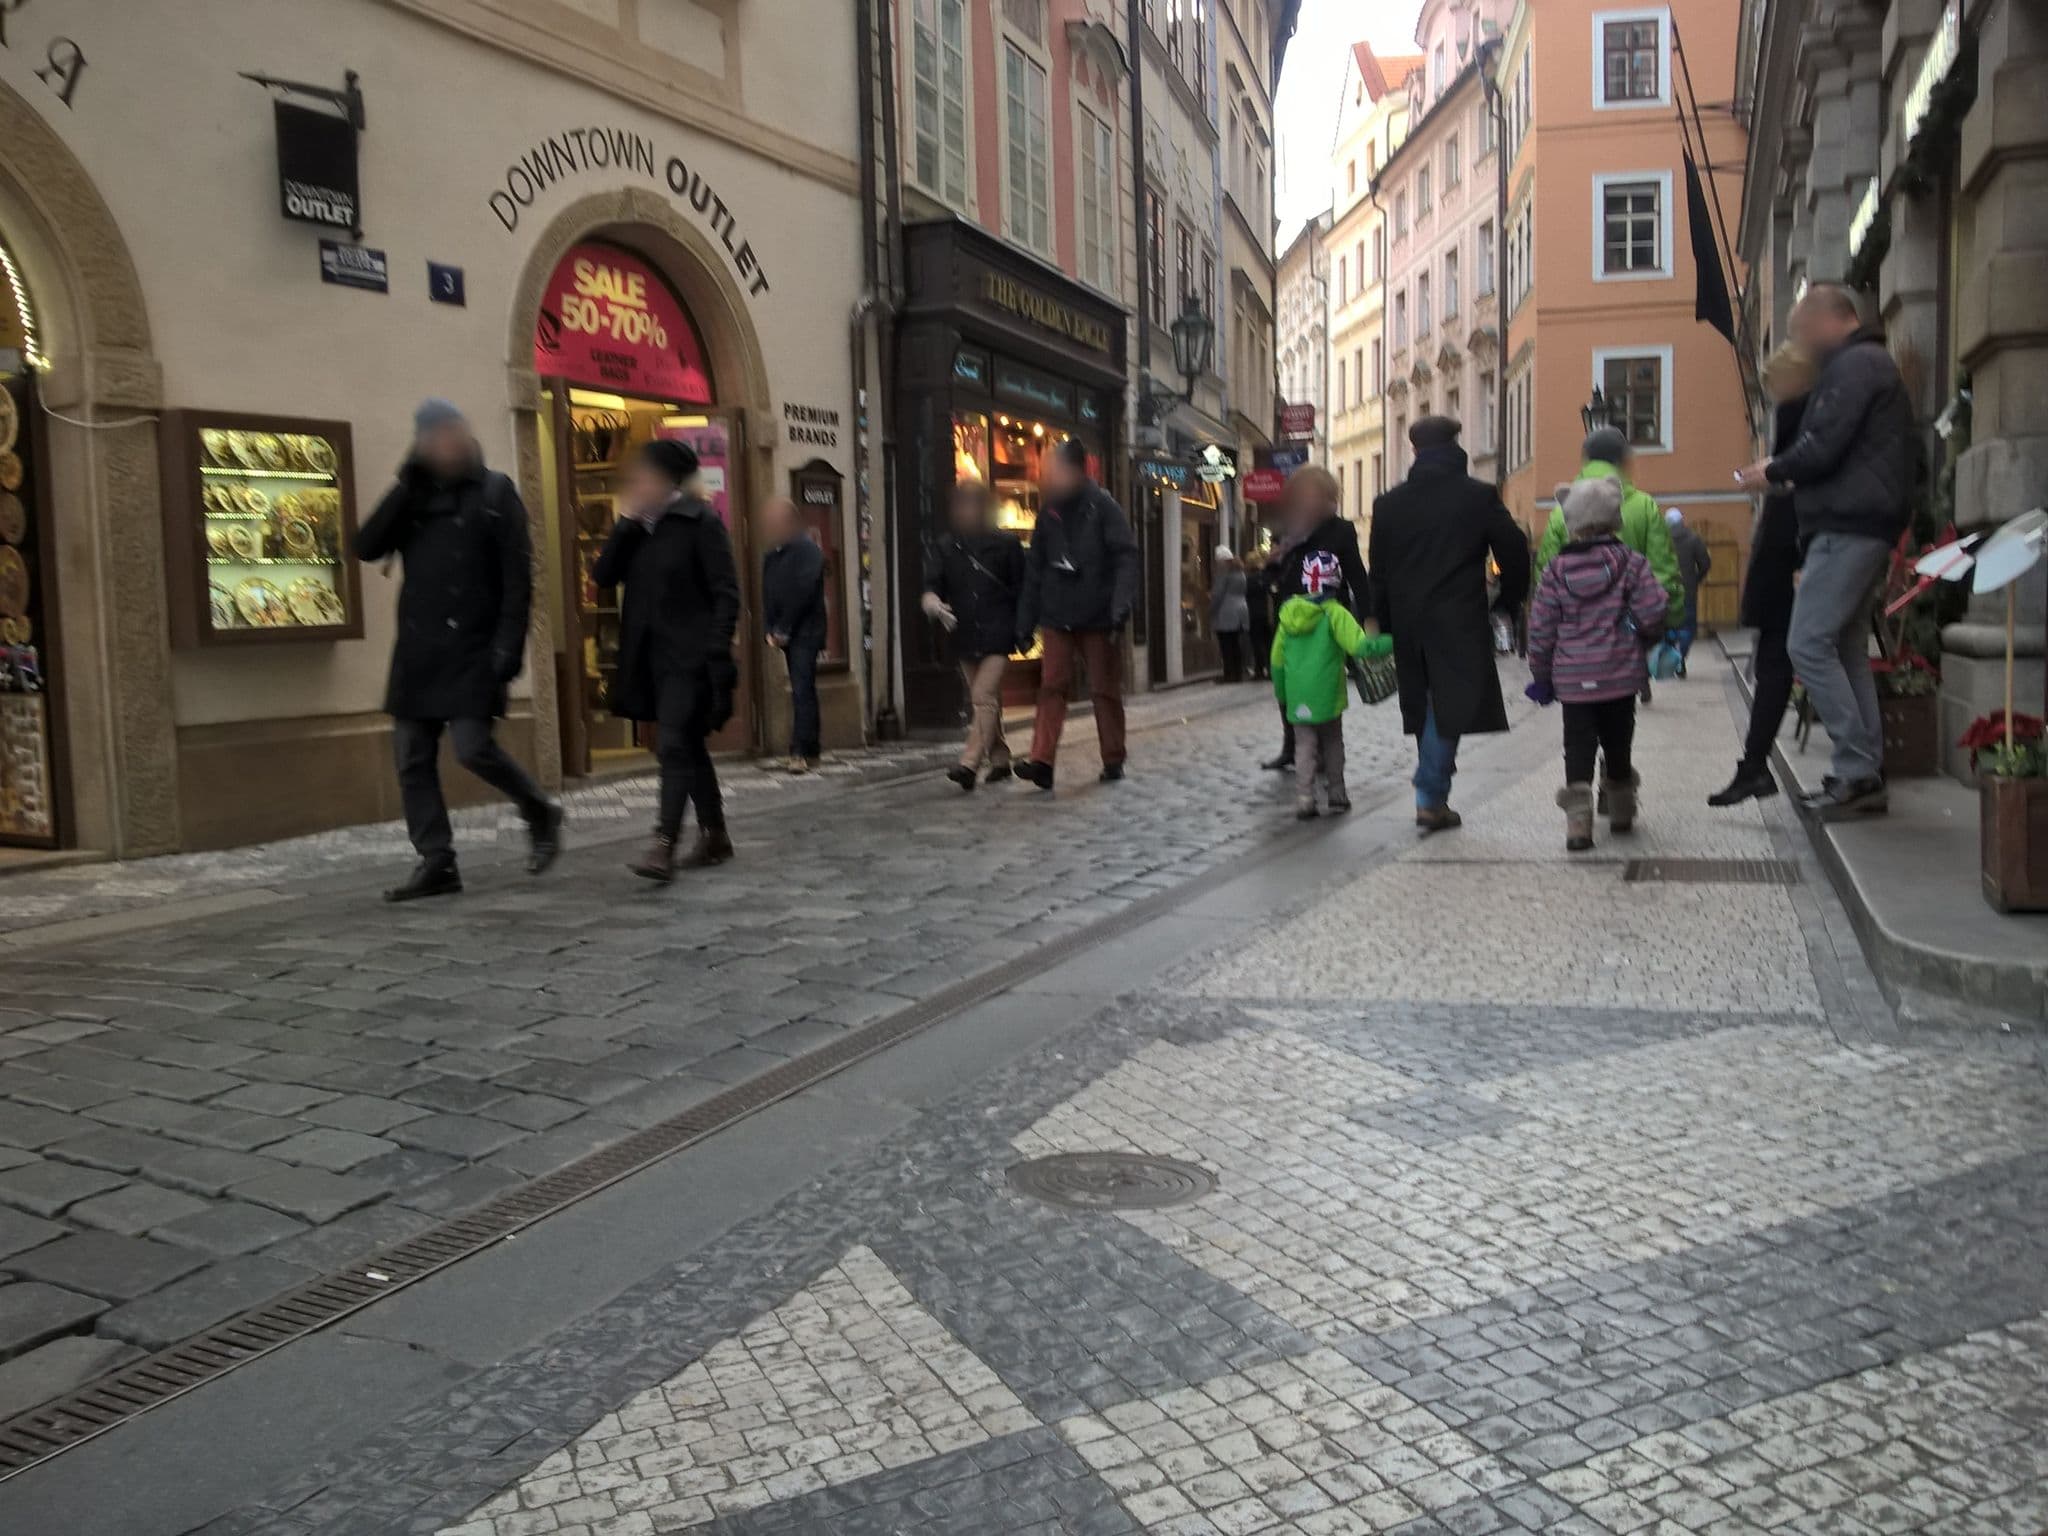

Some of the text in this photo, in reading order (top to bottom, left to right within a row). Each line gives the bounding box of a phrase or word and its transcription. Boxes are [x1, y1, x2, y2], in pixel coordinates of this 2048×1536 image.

[286, 193, 354, 226] OUTLET
[489, 127, 770, 298] DOWNTOWN OUTLET
[442, 272, 456, 295] 3
[573, 258, 648, 310] SALE
[561, 292, 668, 350] 50-70%
[784, 402, 840, 428] PREMIUM
[788, 425, 838, 448] BRANDS
